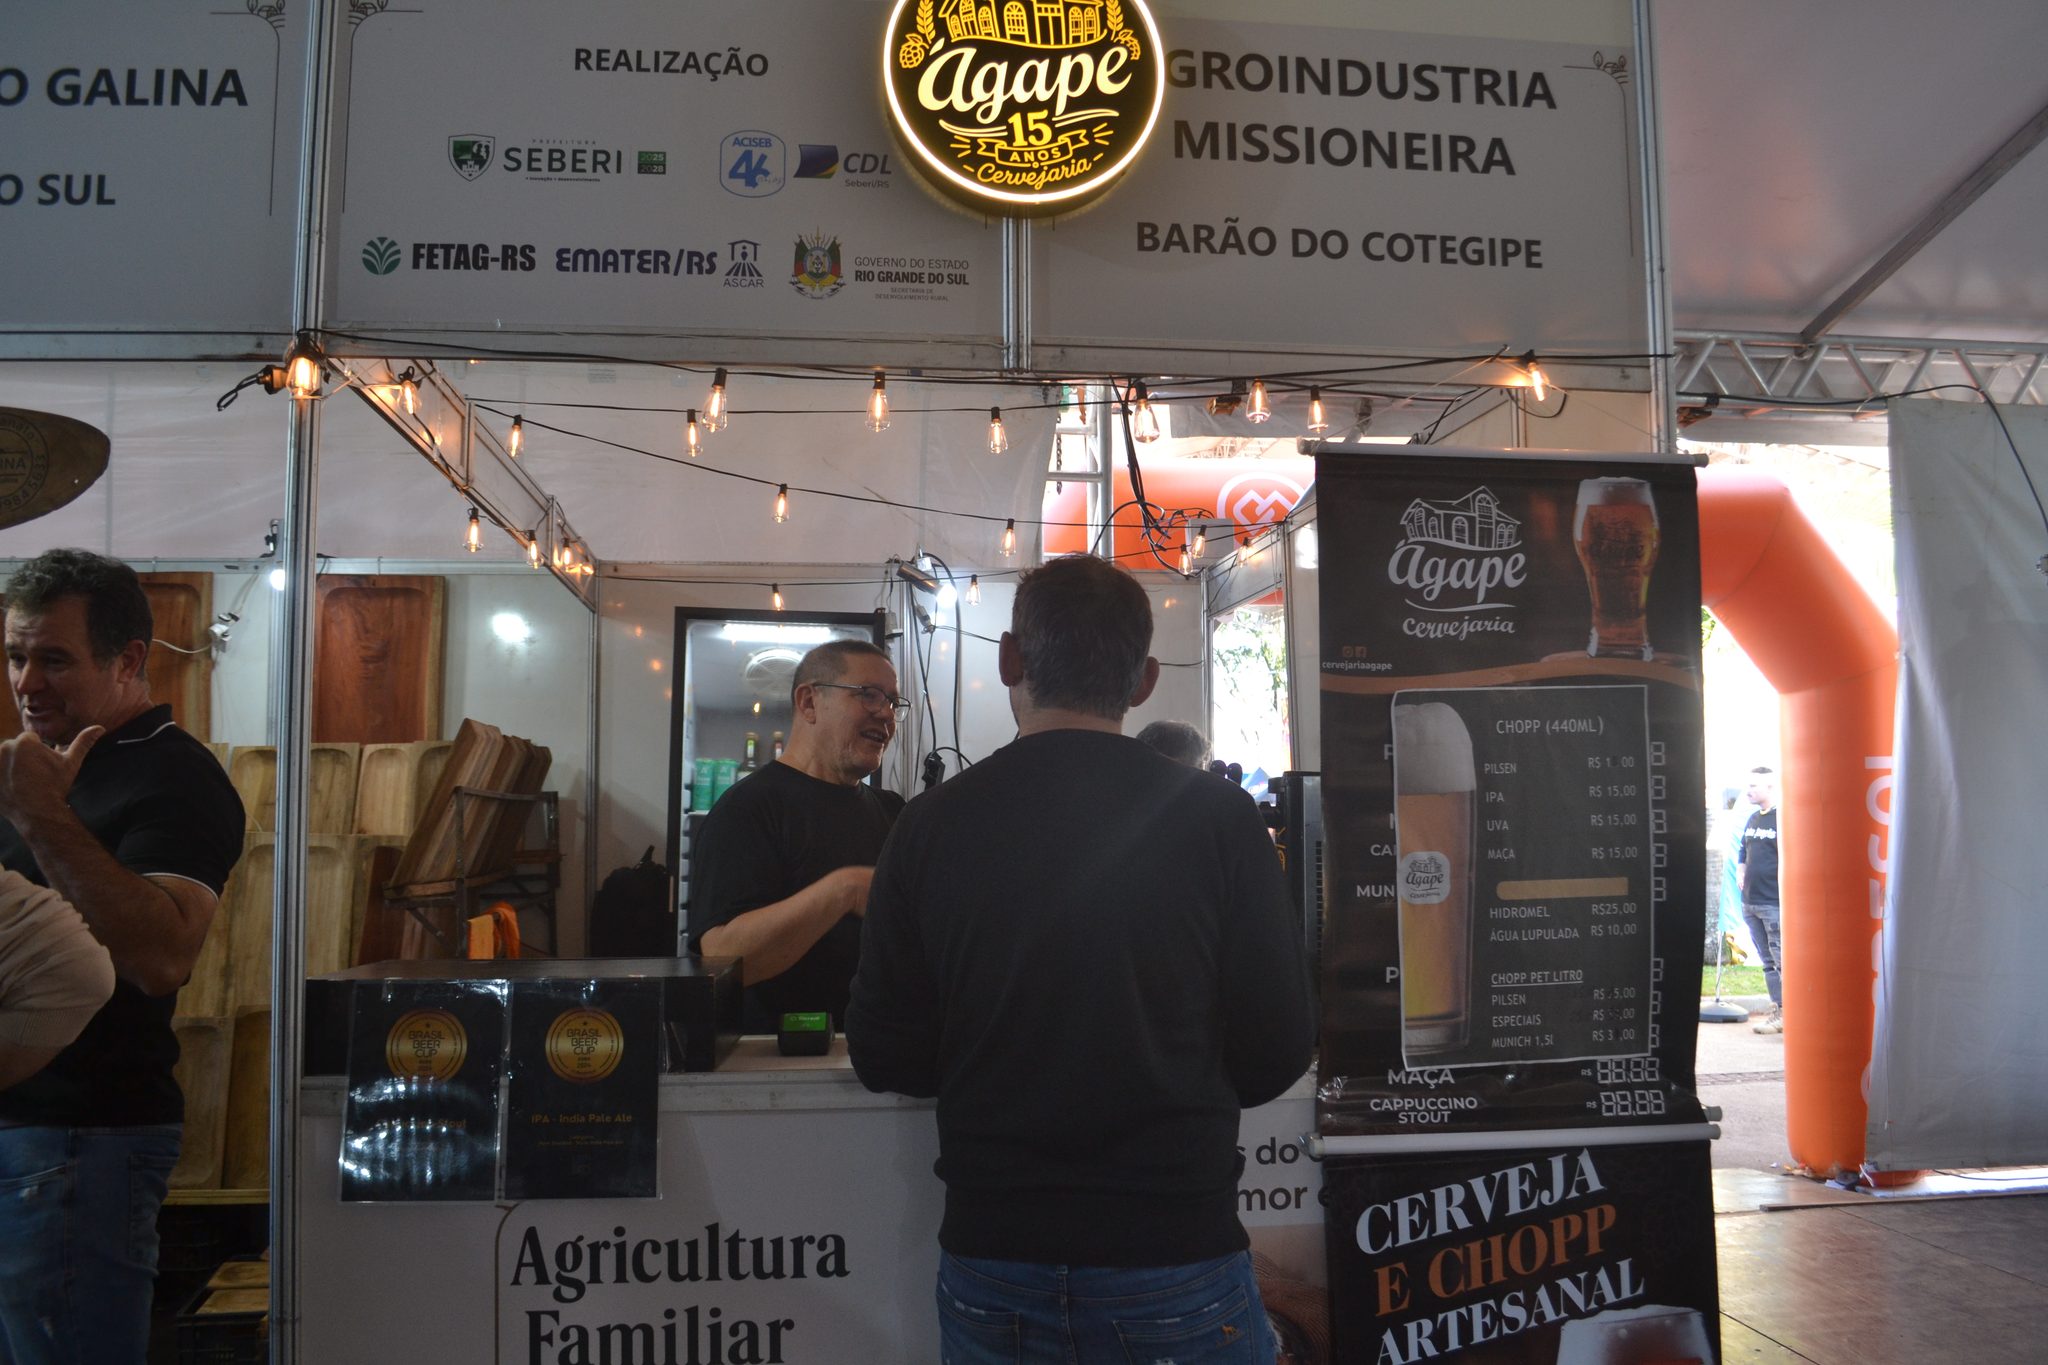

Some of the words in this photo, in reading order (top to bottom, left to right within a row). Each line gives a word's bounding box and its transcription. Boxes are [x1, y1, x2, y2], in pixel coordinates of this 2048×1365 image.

[574, 46, 769, 82] REALIZAÇÃO
[46, 67, 249, 107] GALINA
[1165, 50, 1557, 110] GROINDUSTRIA
[1007, 109, 1052, 147] 15
[732, 137, 772, 148] ACISEB
[1174, 120, 1516, 176] MISSIONEIRA
[503, 147, 622, 174] SEBERI
[1009, 147, 1061, 162] ANOS
[843, 153, 892, 175] CDL
[977, 157, 1092, 190] Cervejaria
[37, 173, 117, 206] SUL
[845, 179, 890, 188] Seberi/RS
[1136, 218, 1277, 257] BARÃO
[1291, 228, 1348, 260] DO
[1361, 231, 1543, 269] COTEGIPE
[412, 243, 536, 272] FETAG-RS
[555, 247, 717, 276] EMATER/RS
[854, 256, 906, 268] GOVERNO
[910, 258, 925, 269] DO
[928, 259, 969, 270] ESTADO
[723, 278, 764, 288] ASCAR
[855, 270, 876, 282] RIO
[877, 271, 925, 284] GRANDE
[927, 272, 945, 285] DO
[947, 273, 970, 286] SUL
[1402, 615, 1516, 641] Cervejaria
[1321, 660, 1393, 672] cervejariaagape
[1496, 719, 1541, 734] CHOPP
[1545, 715, 1605, 735] (440ML)
[1484, 762, 1518, 775] PILSEN
[1485, 791, 1505, 803] IPA
[1486, 820, 1510, 832] UVA
[1607, 813, 1637, 828] 15,00
[1609, 846, 1638, 860] 15,00
[1489, 905, 1551, 919] HIDROMEL
[1522, 928, 1580, 941] LUPULADA
[1491, 972, 1527, 984] CHOPP
[1530, 971, 1550, 983] PET
[1553, 969, 1583, 982] LITRO
[1491, 994, 1526, 1006] PILSEN
[1607, 987, 1636, 999] 5,00
[1492, 1014, 1542, 1027] ESPECIAIS
[1491, 1035, 1531, 1048] MUNICH
[1369, 1097, 1478, 1111] CAPPUCCINO
[531, 1113, 550, 1124] IPA
[559, 1113, 586, 1124] India
[588, 1113, 611, 1123] Pale
[615, 1112, 633, 1123] Ale
[1398, 1110, 1452, 1124] STOUT
[1256, 1136, 1299, 1165] do
[1355, 1146, 1607, 1255] CERVEJA
[510, 1222, 851, 1304] Agricultura
[1373, 1260, 1412, 1317] E
[1427, 1203, 1617, 1300] CHOPP
[1376, 1257, 1646, 1365] ARTESANAL
[525, 1305, 796, 1365] Familiar
